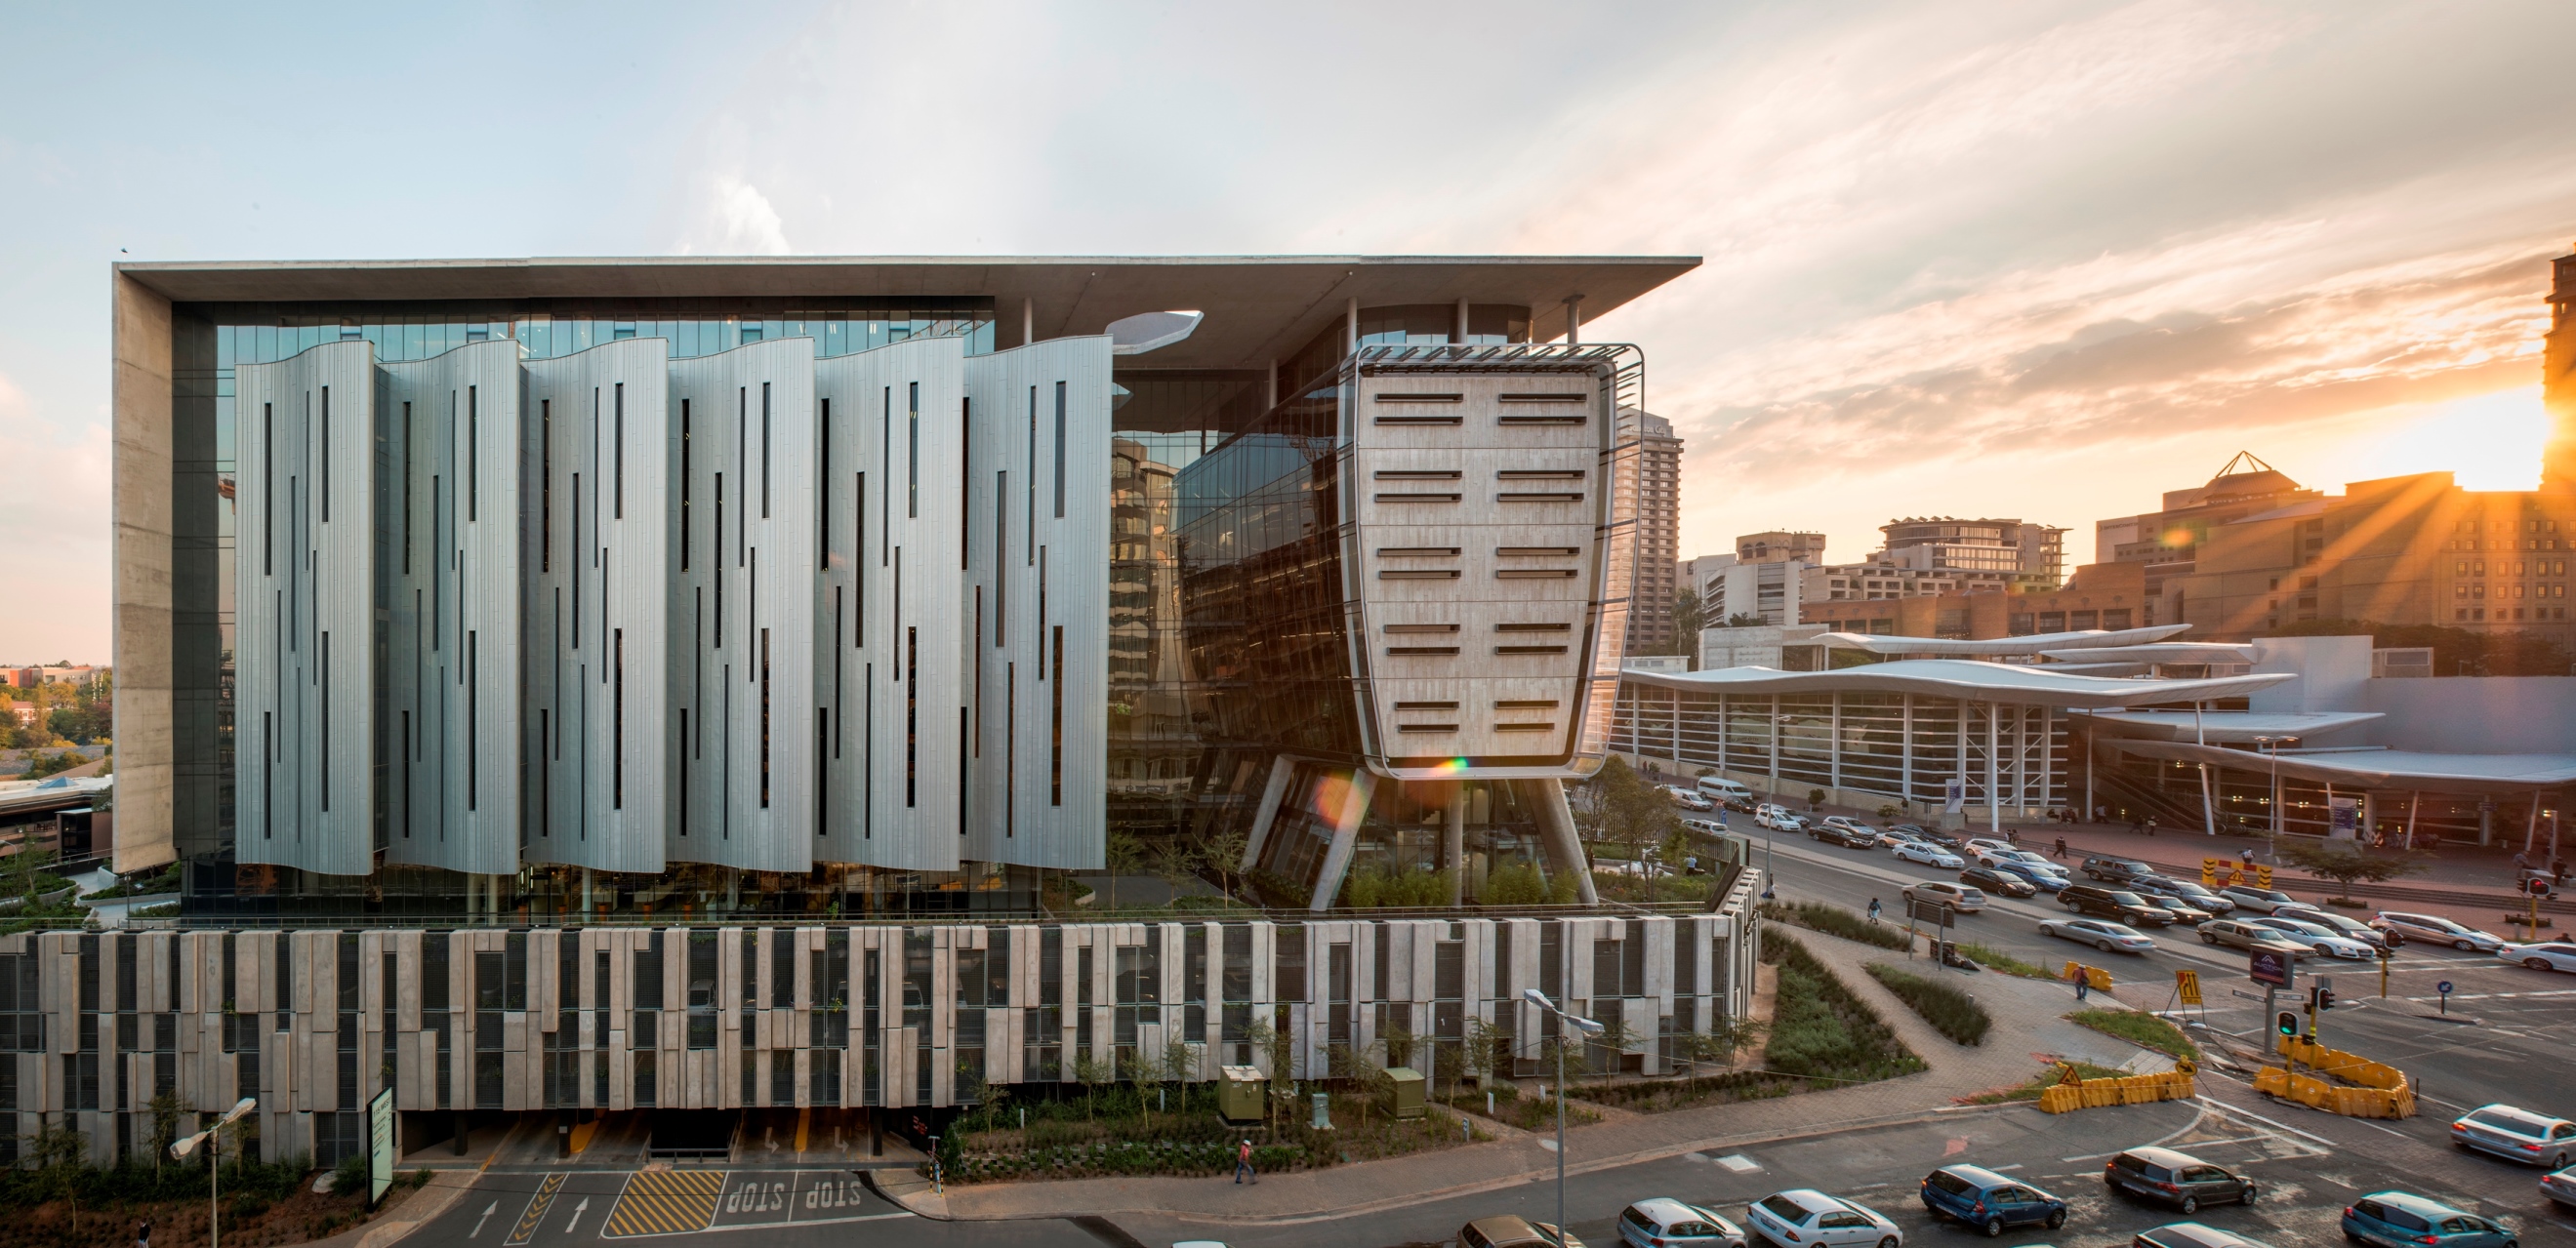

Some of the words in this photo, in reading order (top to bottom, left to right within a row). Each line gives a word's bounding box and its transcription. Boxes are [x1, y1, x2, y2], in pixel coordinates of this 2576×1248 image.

[1628, 424, 1655, 434] Santon
[380, 1096, 391, 1111] WEST
[726, 1182, 785, 1213] STOP
[805, 1181, 862, 1209] STOP
